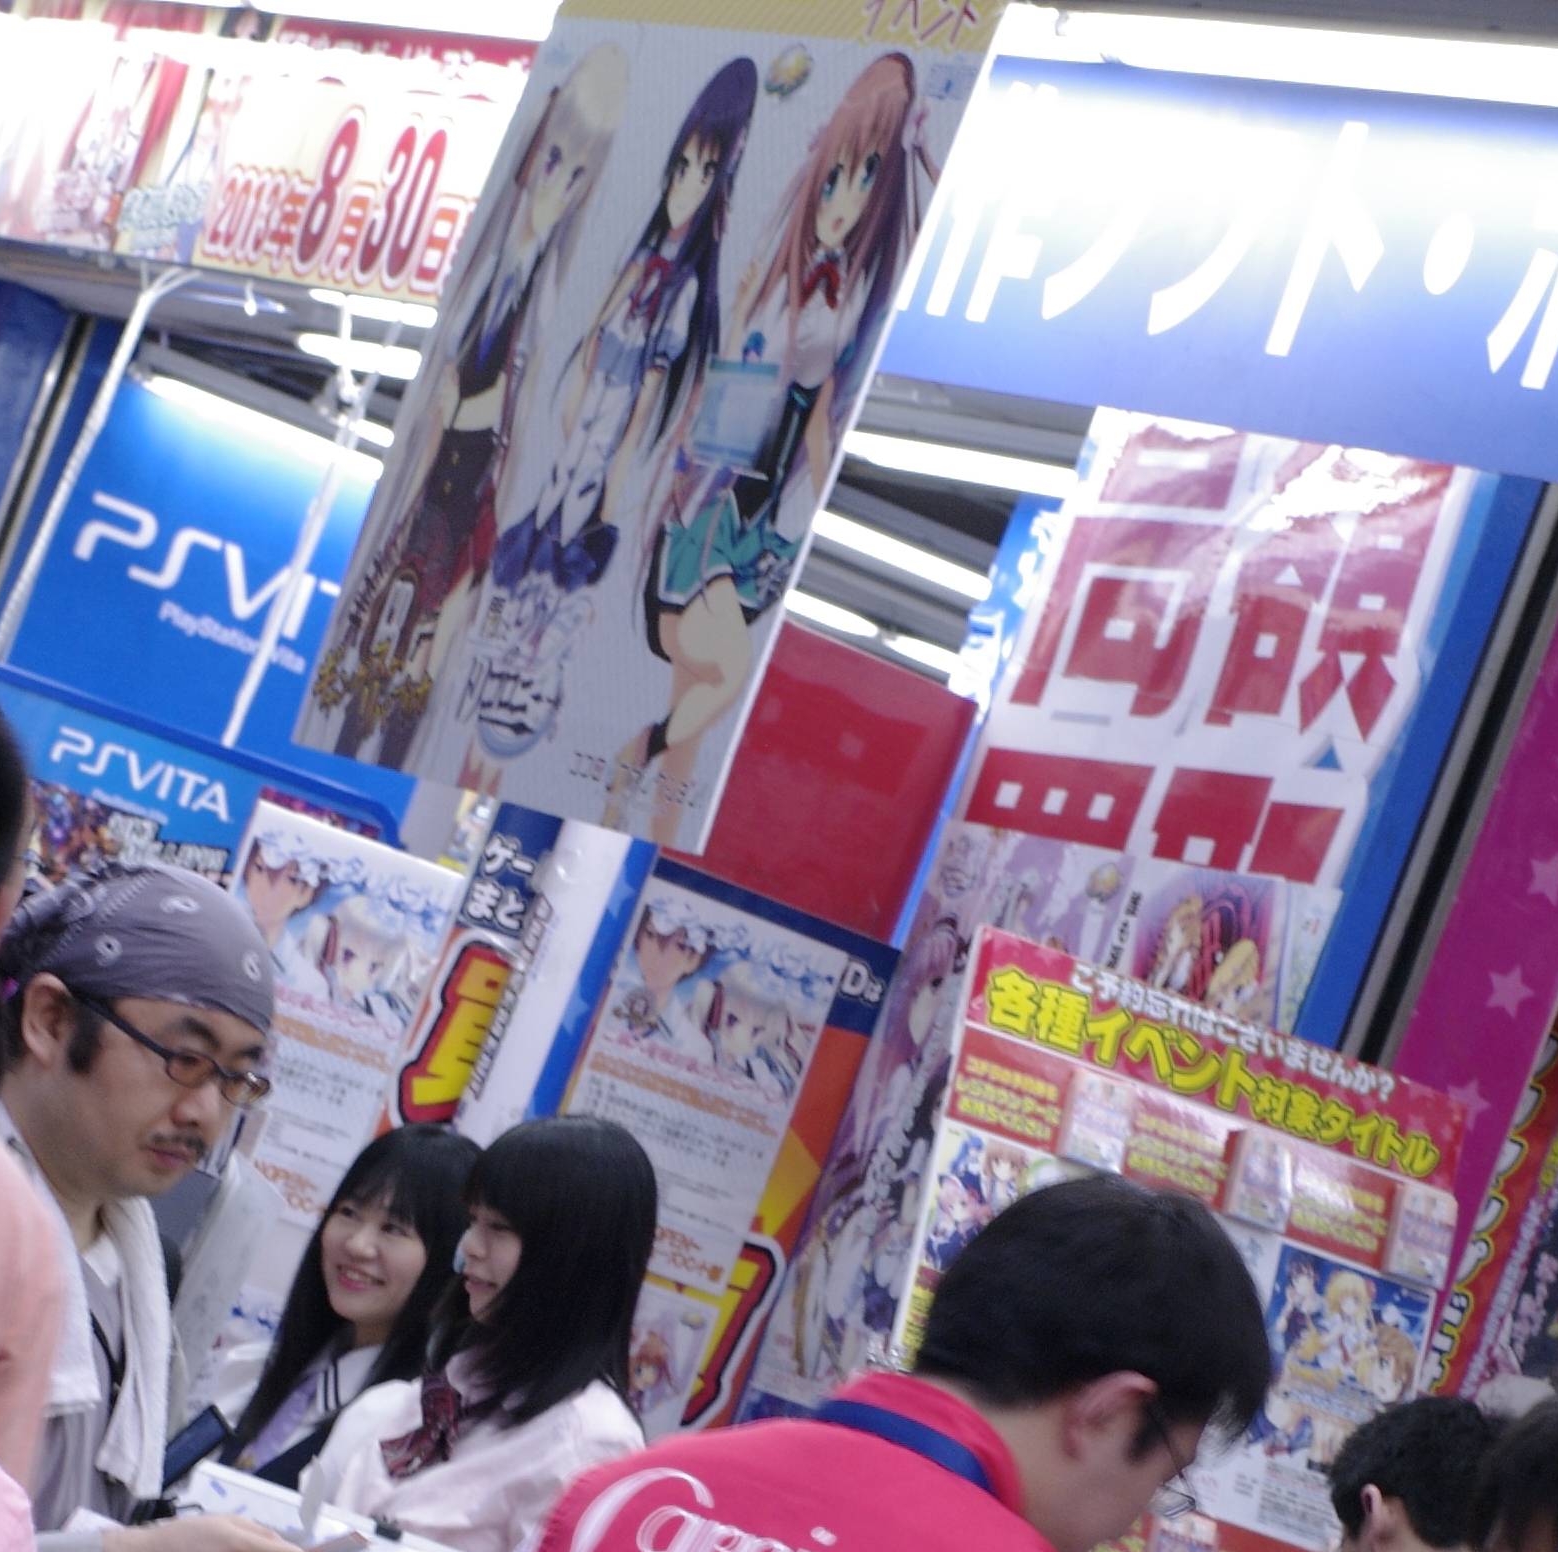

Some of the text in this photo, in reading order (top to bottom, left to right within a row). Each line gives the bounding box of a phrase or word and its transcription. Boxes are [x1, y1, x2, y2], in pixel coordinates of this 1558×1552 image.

[201, 103, 465, 295] 2013年8月30日
[49, 726, 233, 824] PSVITA
[985, 964, 1442, 1181] 各種イベント対象タイトル
